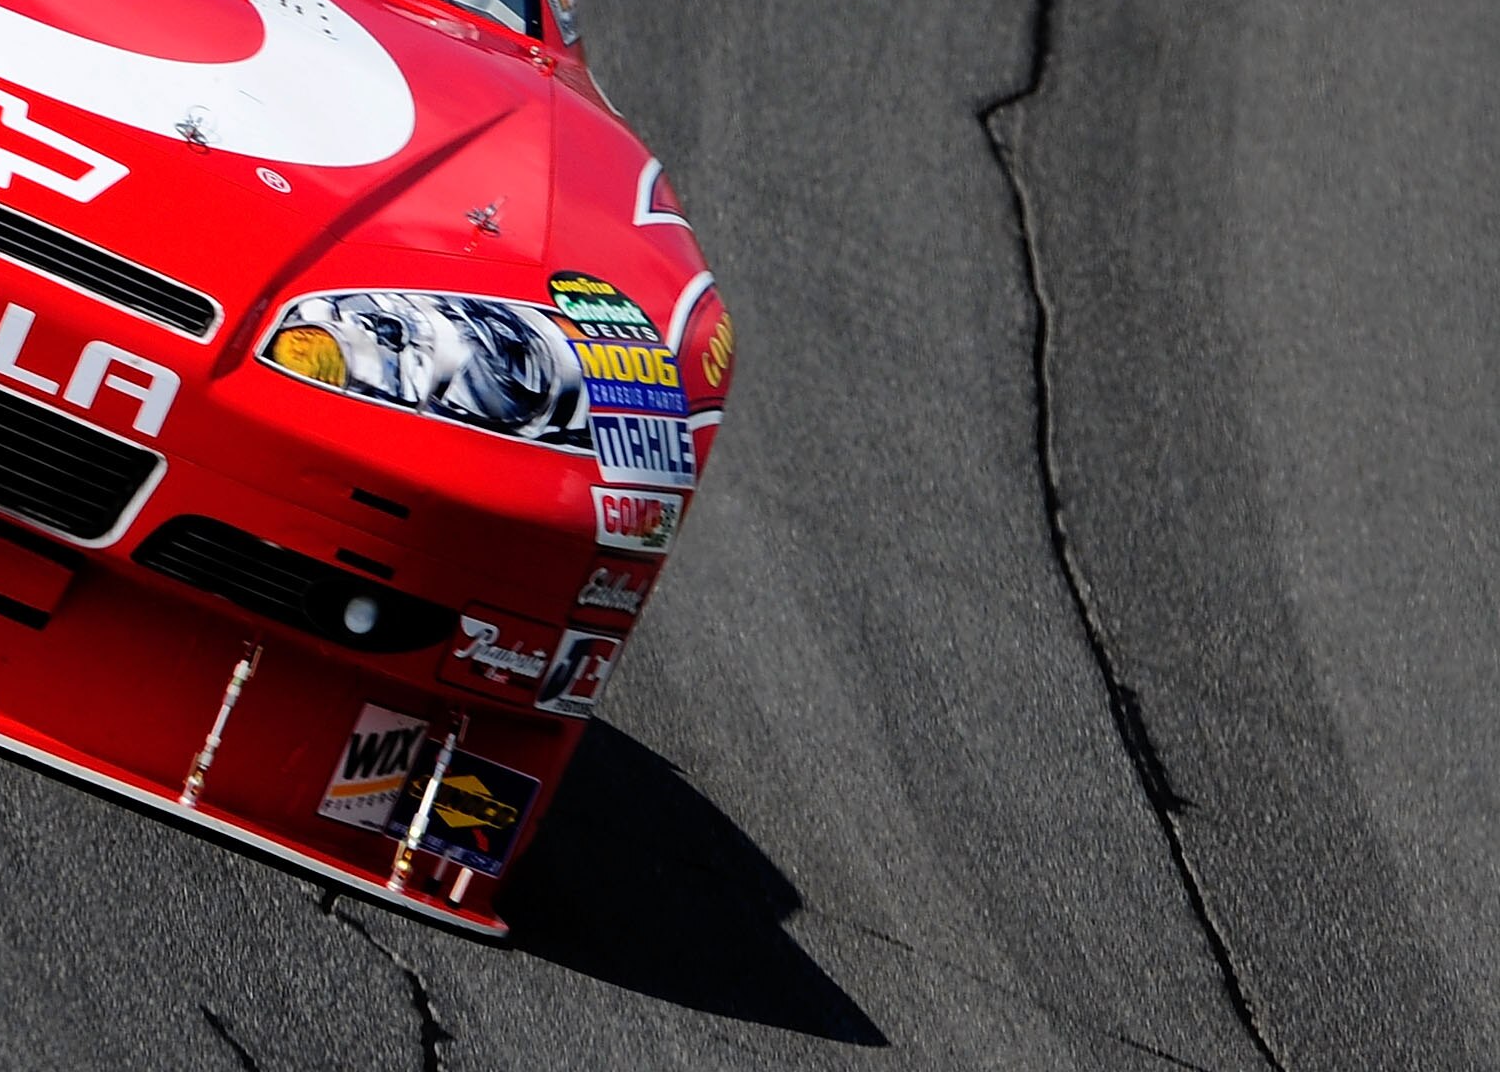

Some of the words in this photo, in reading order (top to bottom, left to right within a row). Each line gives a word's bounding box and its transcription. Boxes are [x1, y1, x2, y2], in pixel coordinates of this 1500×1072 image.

[580, 323, 660, 343] BELTS
[574, 341, 680, 389] MOOG
[592, 415, 694, 474] MAHLE
[343, 725, 426, 781] WIX
